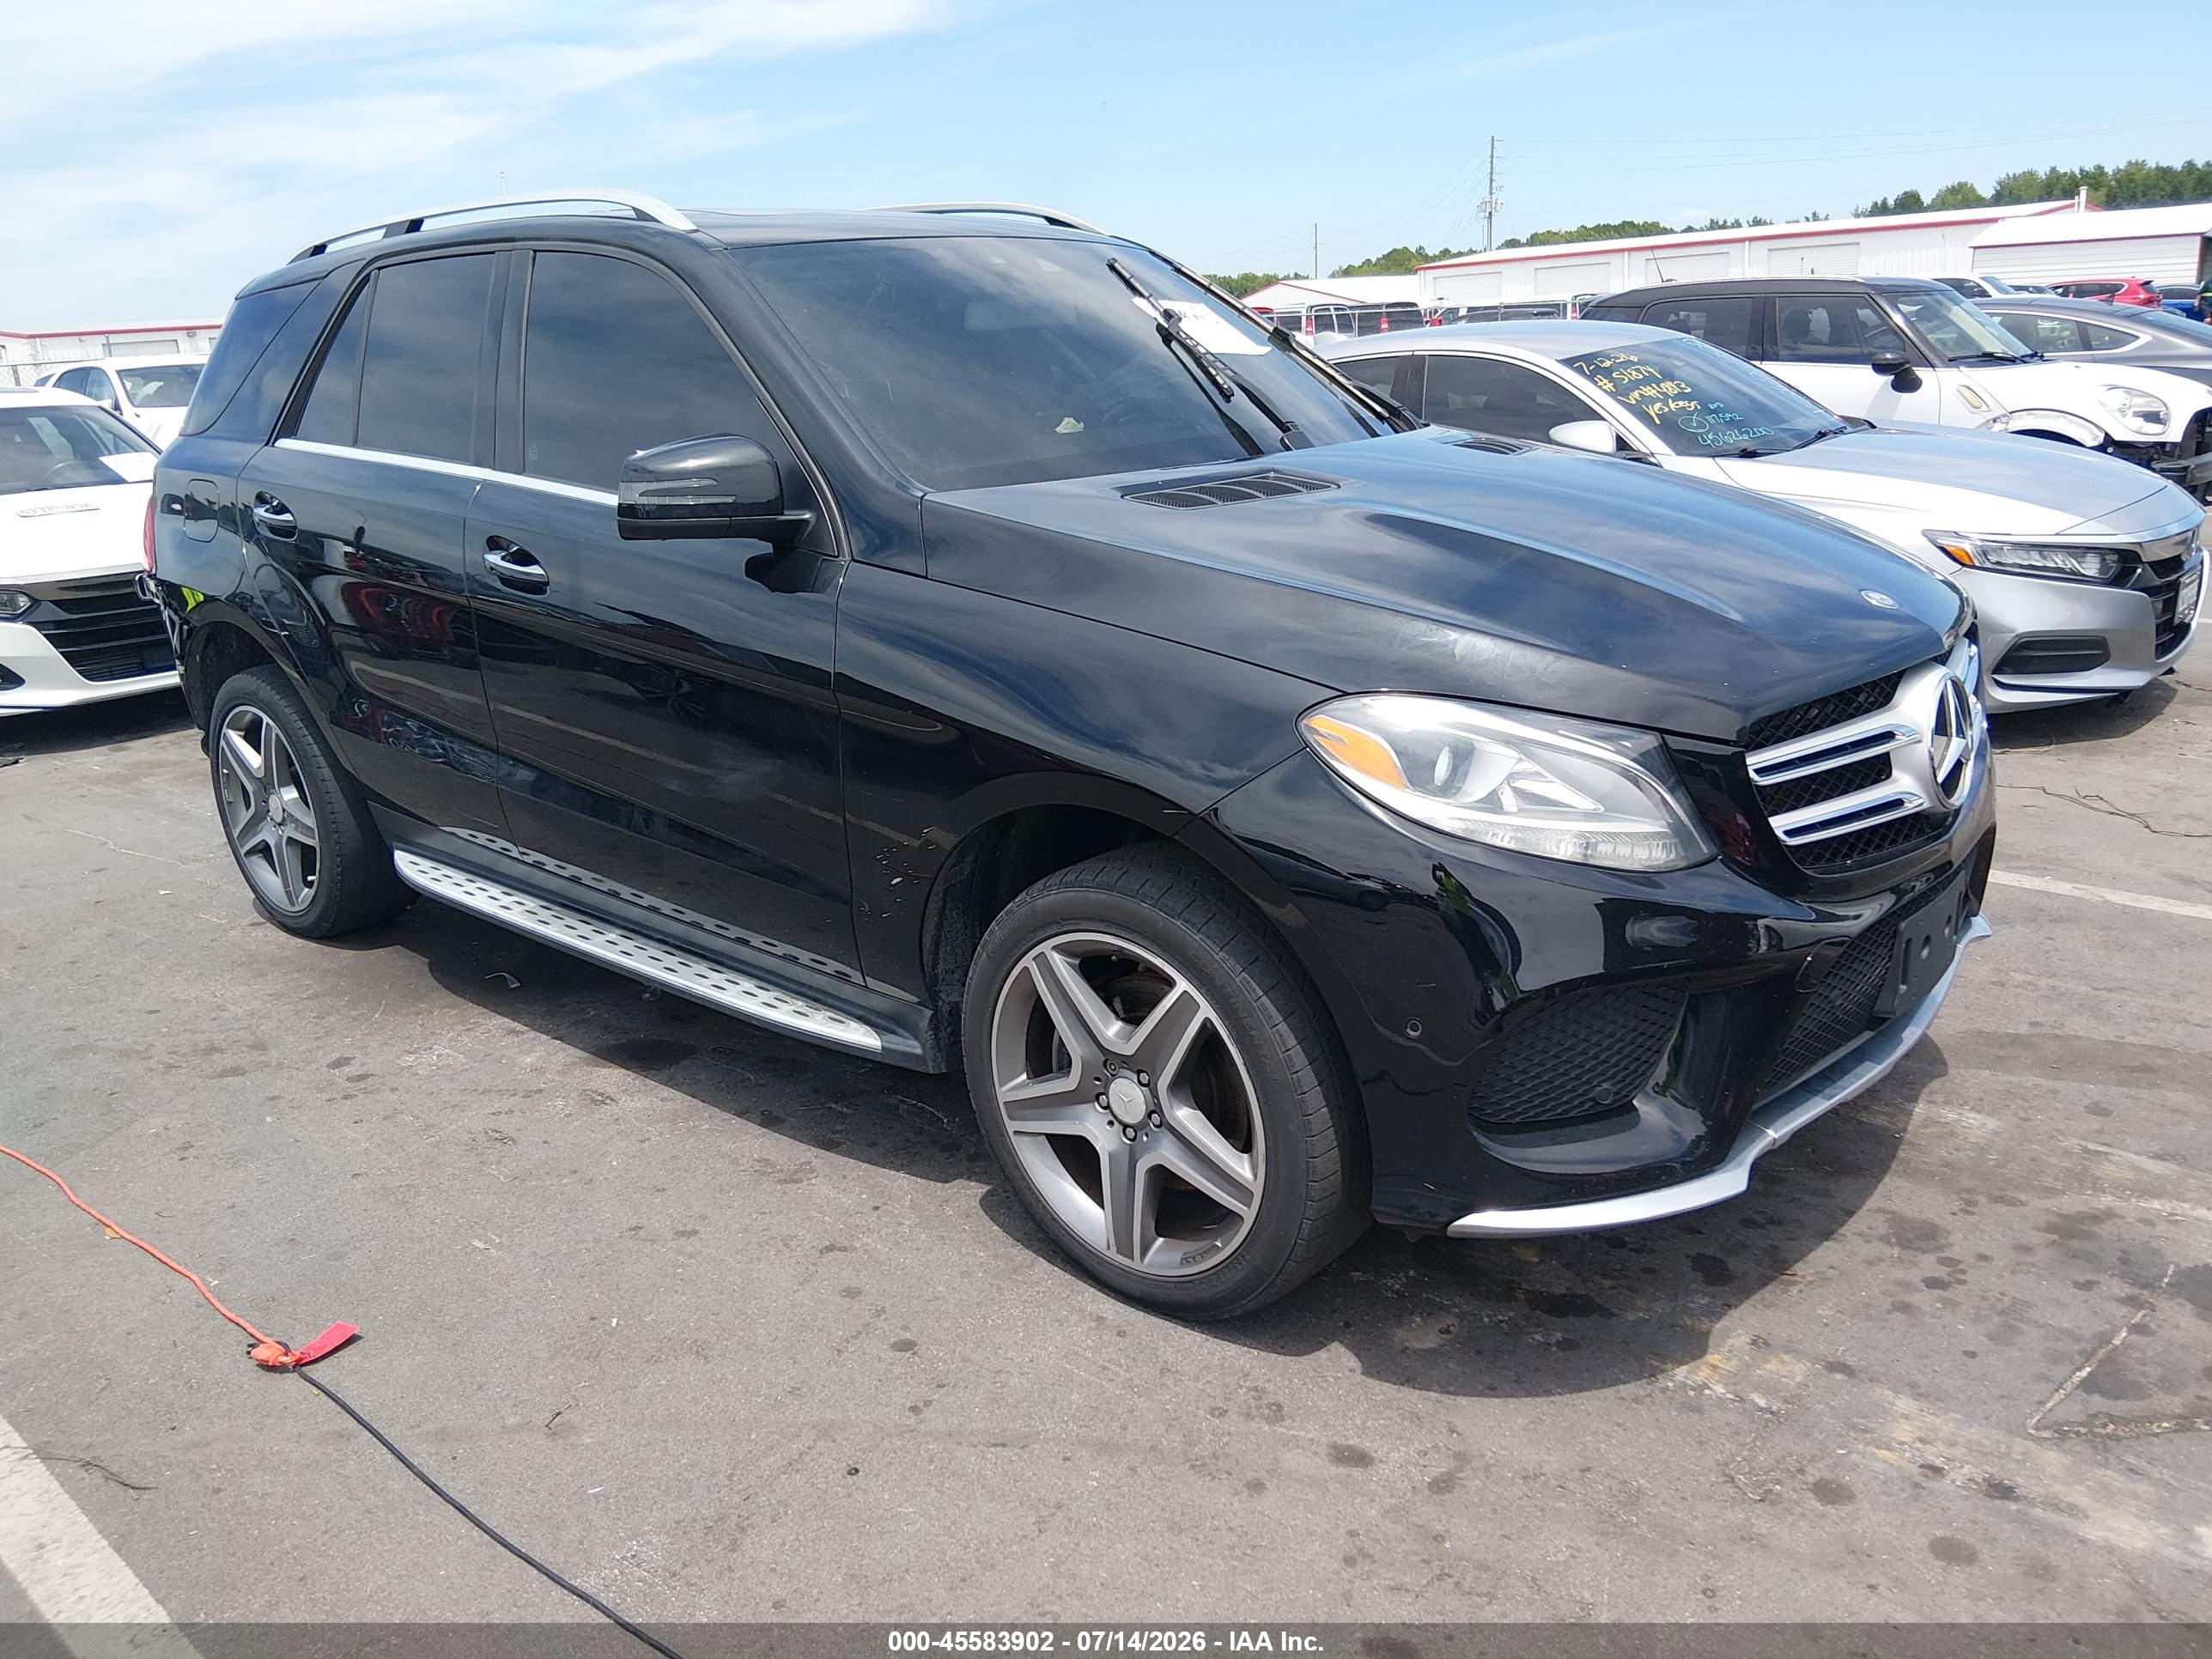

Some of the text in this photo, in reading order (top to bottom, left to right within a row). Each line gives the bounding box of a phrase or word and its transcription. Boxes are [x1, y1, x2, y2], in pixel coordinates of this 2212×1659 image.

[1572, 352, 1639, 375] 7-12-26
[1593, 374, 1617, 392] #
[1697, 425, 1774, 448] 45626200
